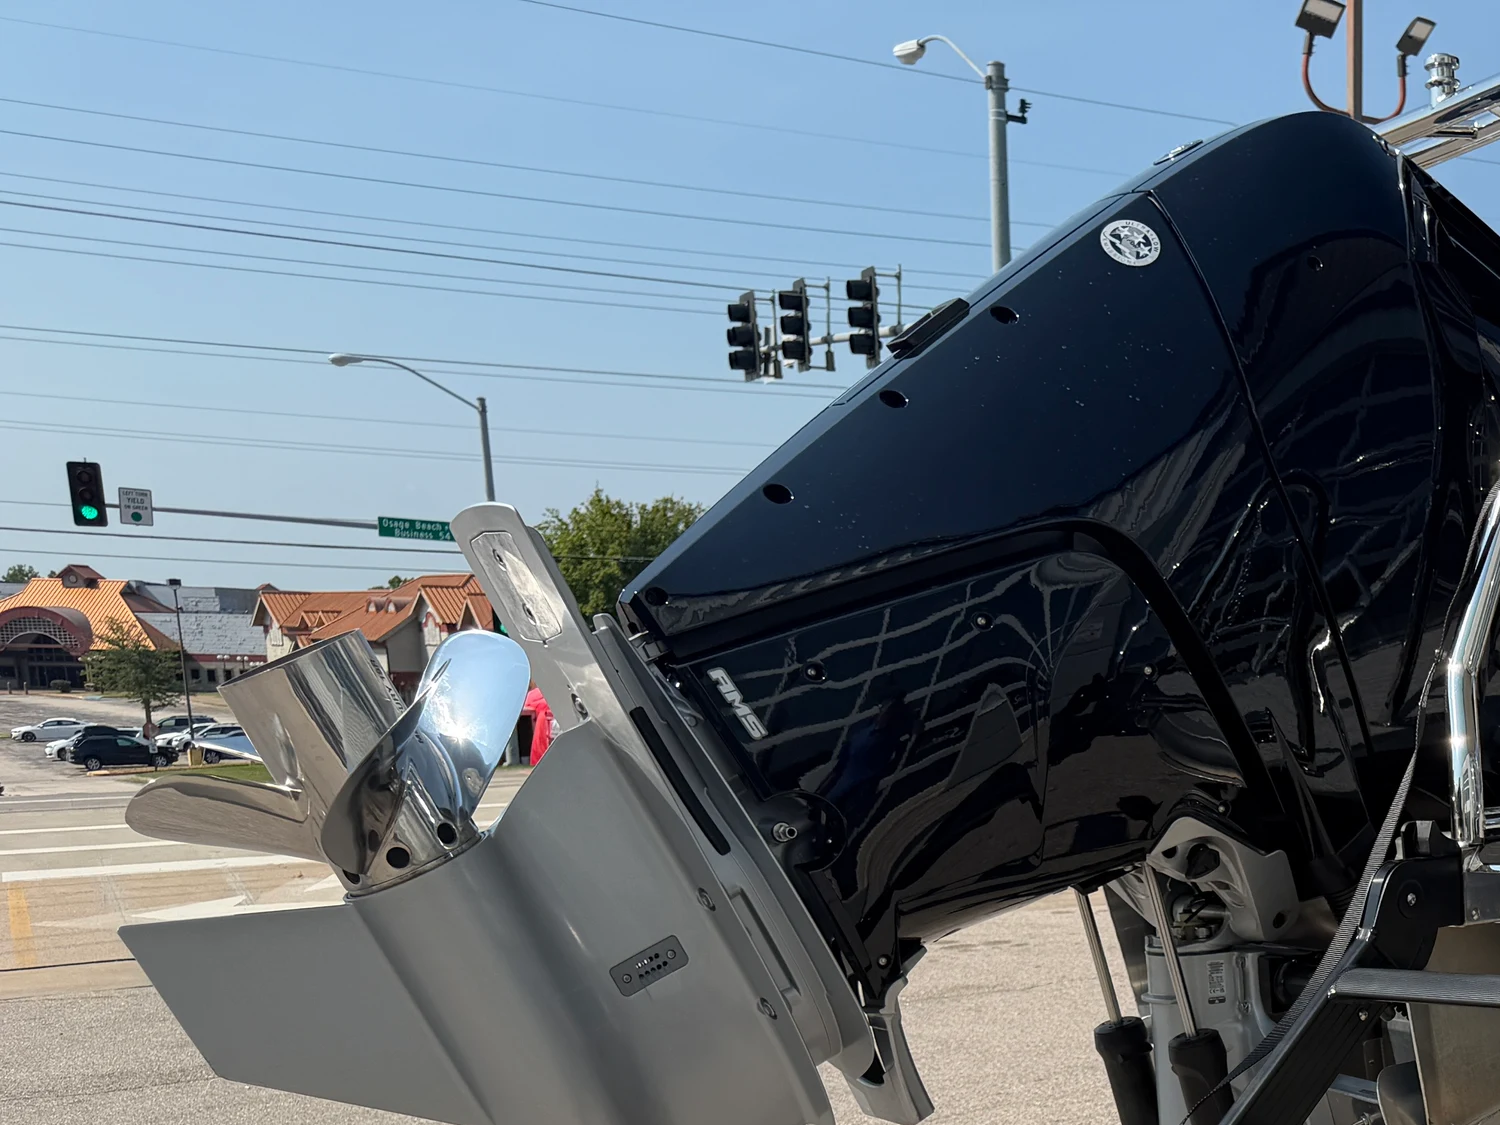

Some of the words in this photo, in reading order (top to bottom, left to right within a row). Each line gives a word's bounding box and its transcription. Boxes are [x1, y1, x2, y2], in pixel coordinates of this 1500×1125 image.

[382, 518, 410, 530] Osage
[415, 521, 442, 531] Beach
[394, 528, 434, 539] Business
[707, 667, 768, 740] AMS
